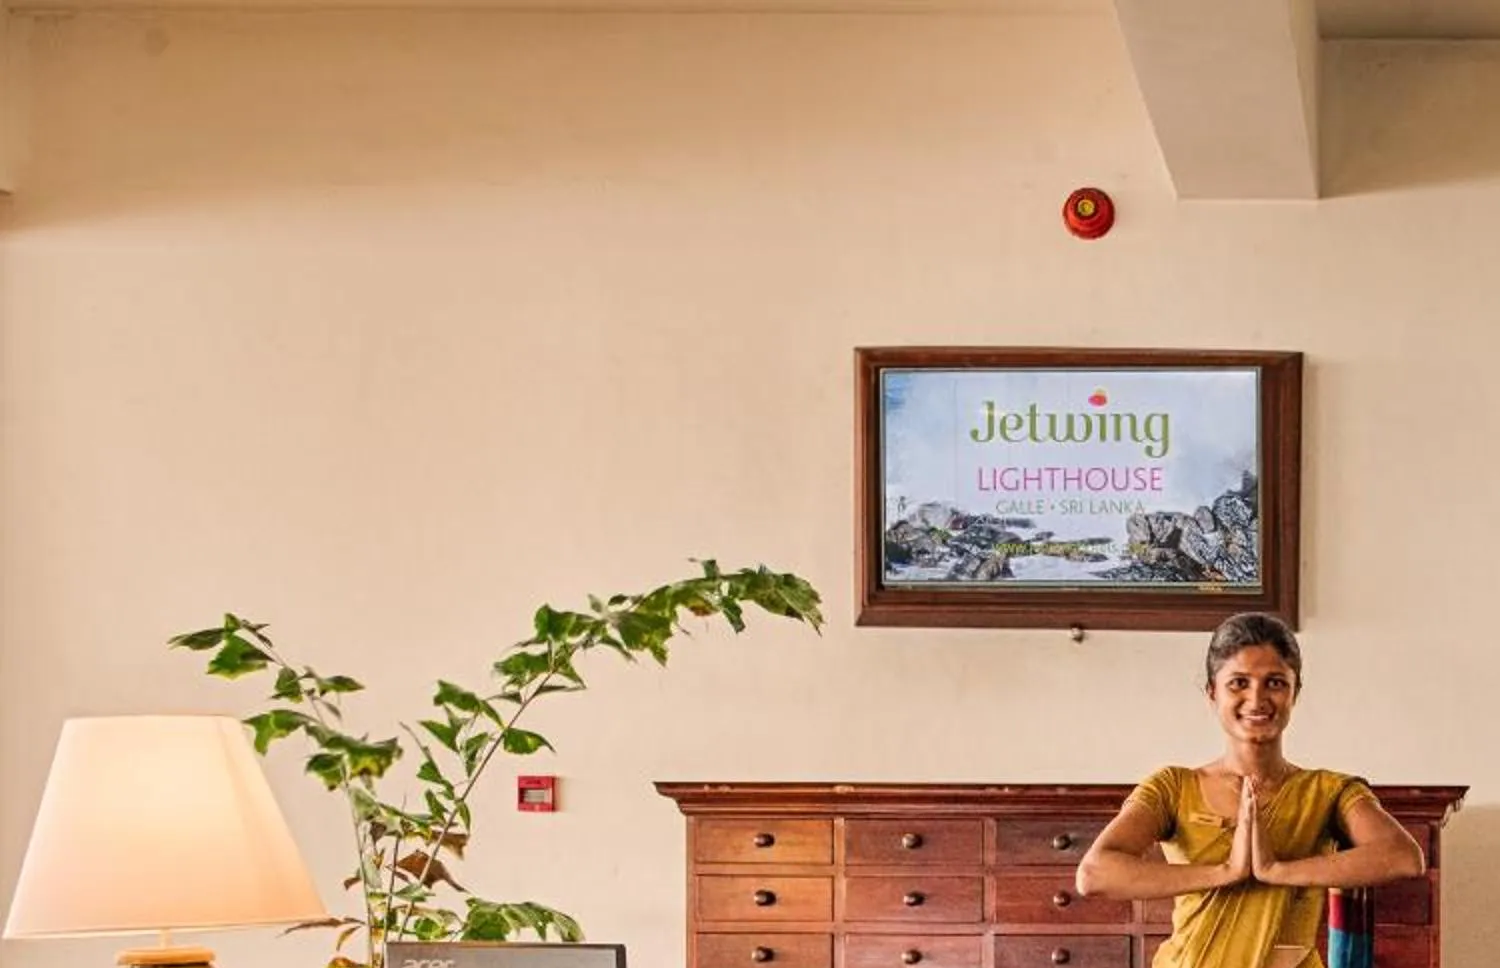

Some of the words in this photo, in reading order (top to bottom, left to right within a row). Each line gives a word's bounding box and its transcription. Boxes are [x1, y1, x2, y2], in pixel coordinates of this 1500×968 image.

[970, 390, 1170, 459] Jetwing
[977, 466, 1164, 492] LIGHTHOUSE
[995, 499, 1044, 515] GALLE
[1059, 499, 1083, 515] SRI
[1089, 499, 1146, 515] LANKA
